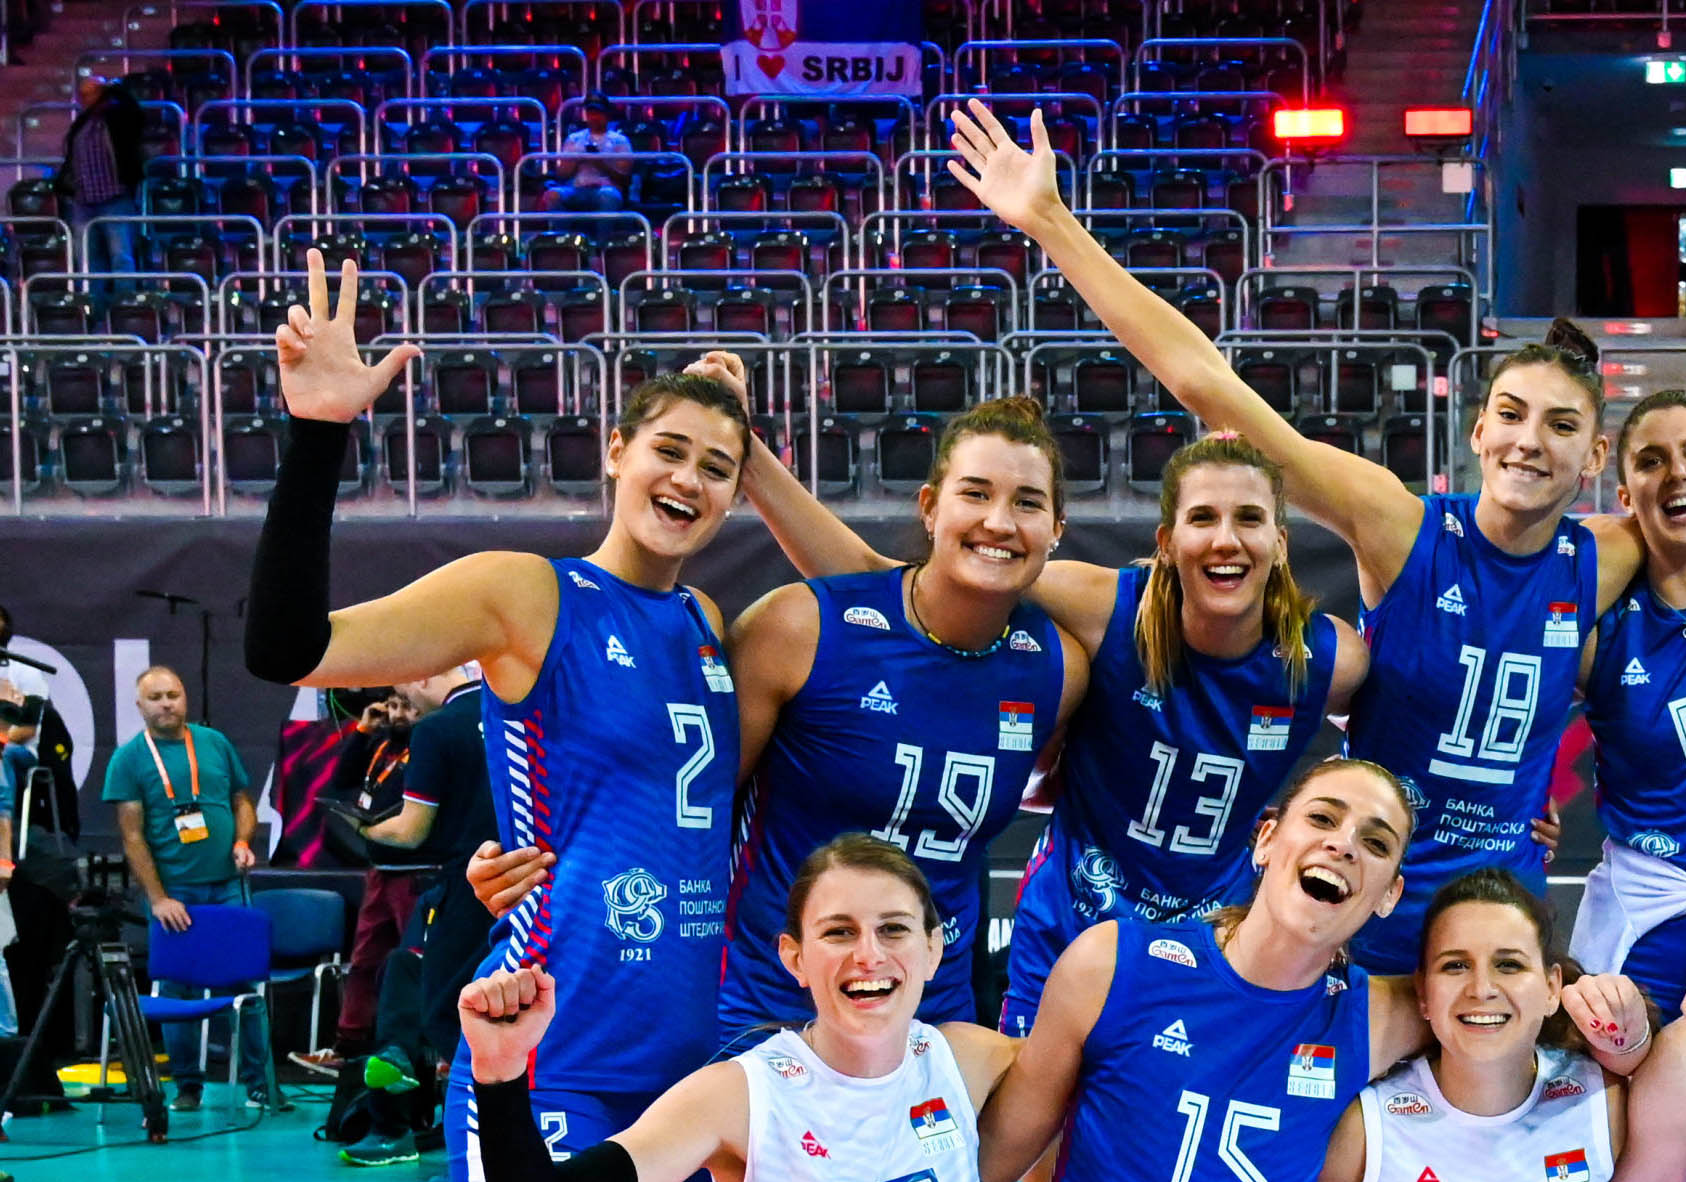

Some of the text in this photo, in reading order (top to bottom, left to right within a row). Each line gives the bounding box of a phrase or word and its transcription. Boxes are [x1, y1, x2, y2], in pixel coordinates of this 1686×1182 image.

[802, 55, 905, 83] SRBIJ
[1436, 597, 1469, 616] PEAK
[1621, 672, 1651, 686] PEAK
[860, 696, 899, 716] PEAK
[1437, 644, 1542, 763] 18
[666, 703, 715, 829] 2
[870, 742, 996, 862] 19
[1127, 741, 1246, 855] 13
[1445, 798, 1495, 818] БАНКА
[1440, 813, 1526, 835] ПОШТАНСКА
[1433, 828, 1516, 852] ШТЕДИОНИ
[679, 879, 712, 894] БАНКА
[619, 948, 652, 961] 1921
[1152, 1034, 1196, 1057] PEAK
[540, 1111, 571, 1162] 2
